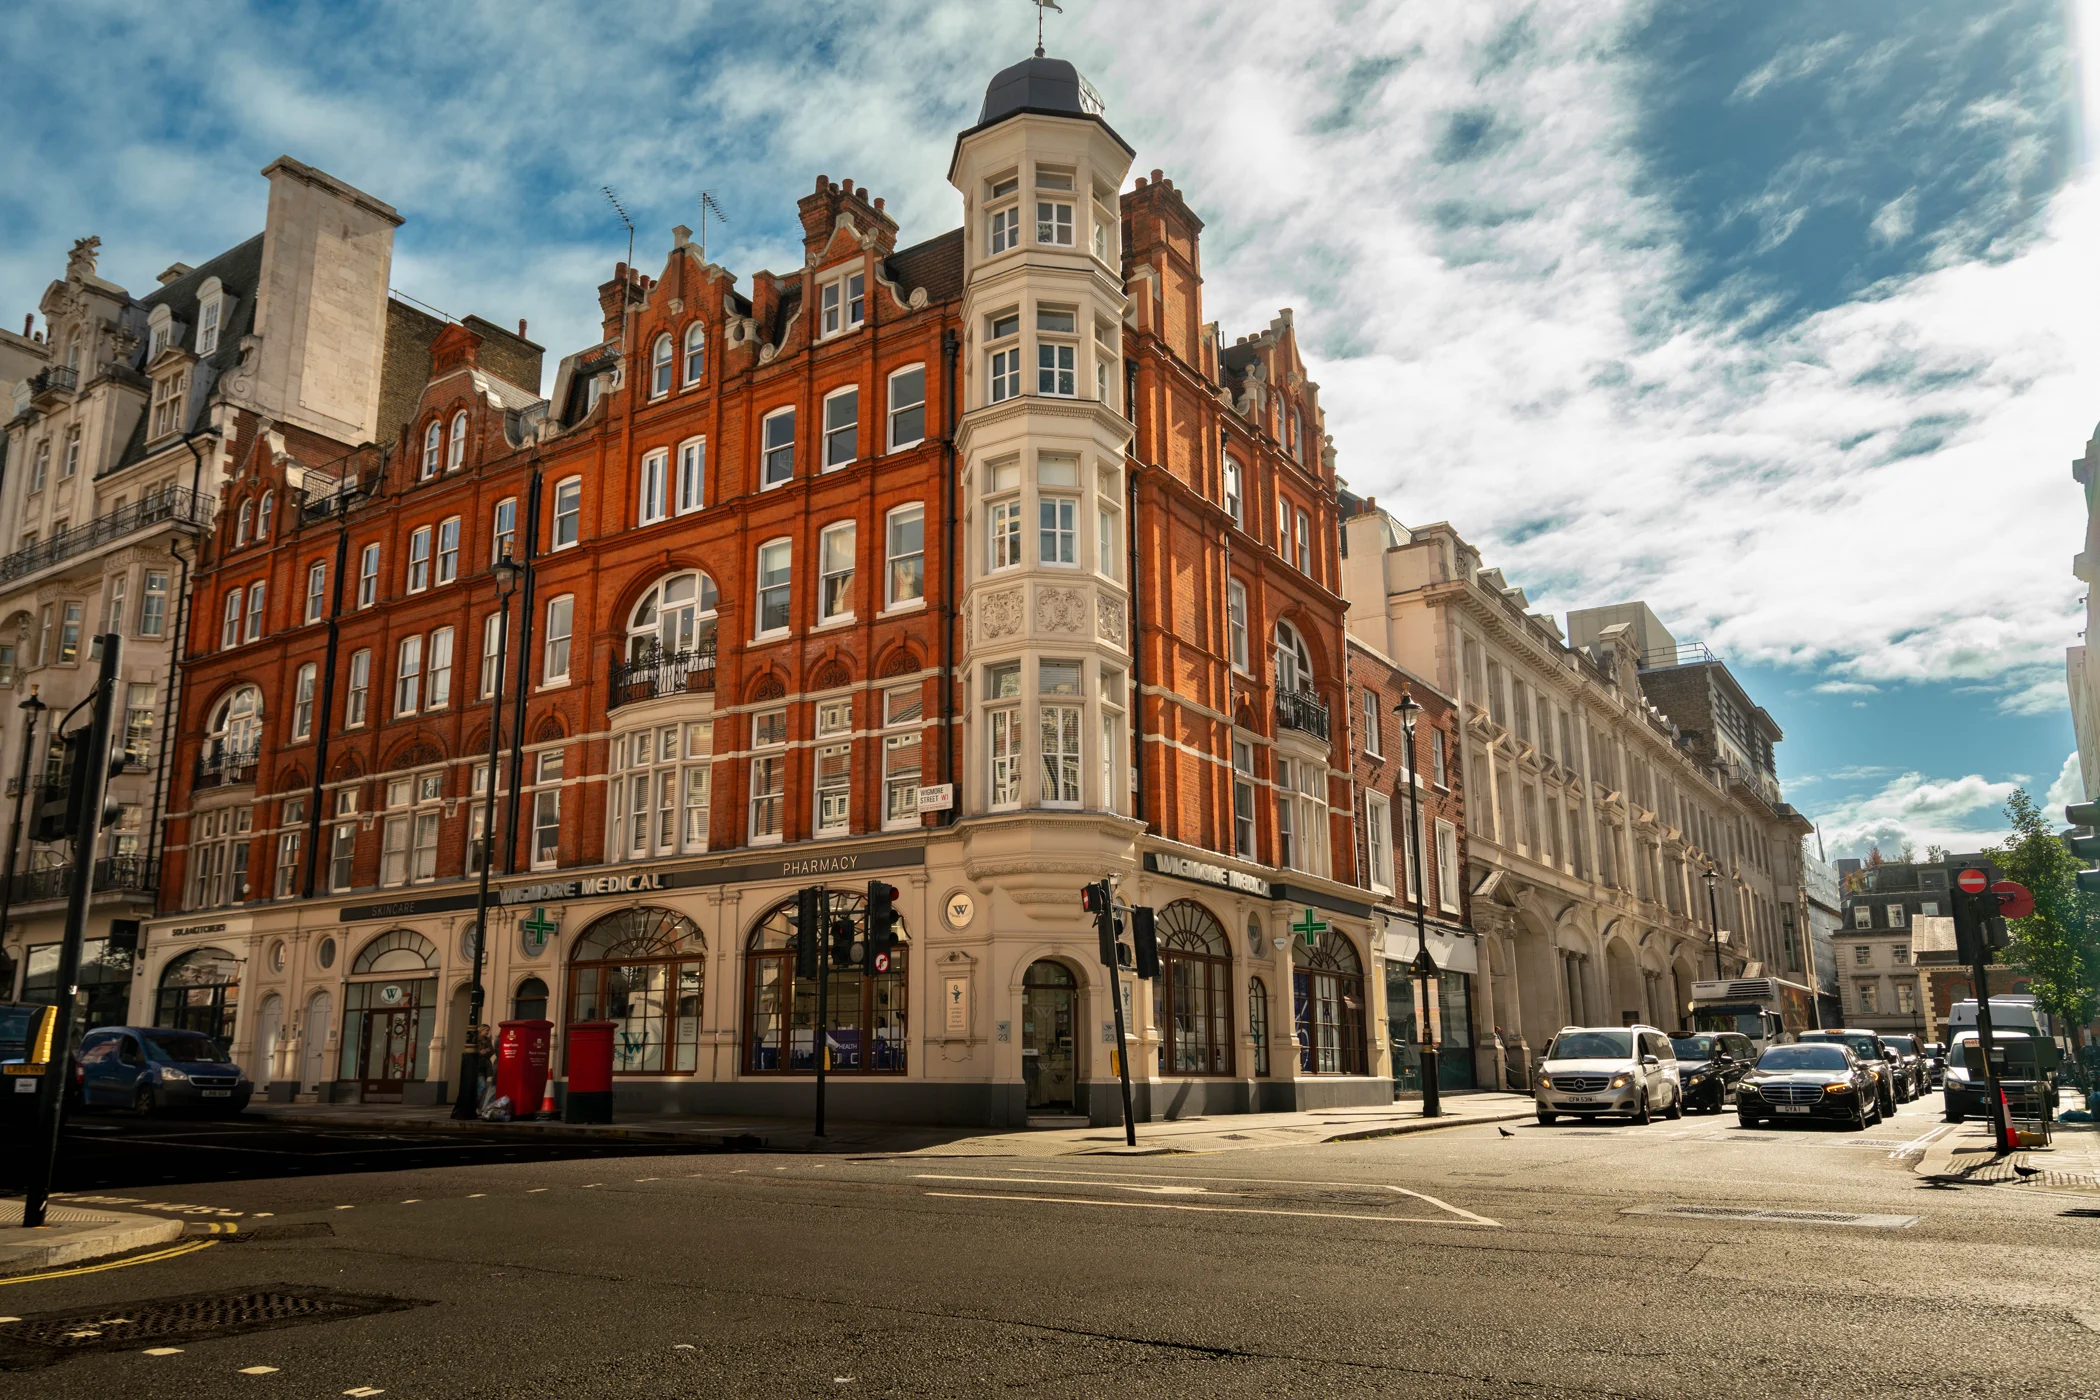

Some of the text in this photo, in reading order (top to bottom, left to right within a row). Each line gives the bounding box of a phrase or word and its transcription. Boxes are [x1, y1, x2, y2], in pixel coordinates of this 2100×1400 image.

[920, 787, 944, 796] WIGMORE
[920, 795, 938, 804] STREET
[783, 855, 858, 875] PHARMACY
[1155, 853, 1228, 885] WIGMORE
[499, 873, 664, 905] WIGMORE MEDICAL
[371, 902, 415, 917] SKINCARE
[952, 904, 969, 916] W
[385, 988, 399, 1000] W
[620, 1032, 649, 1054] W
[998, 1033, 1008, 1042] 23
